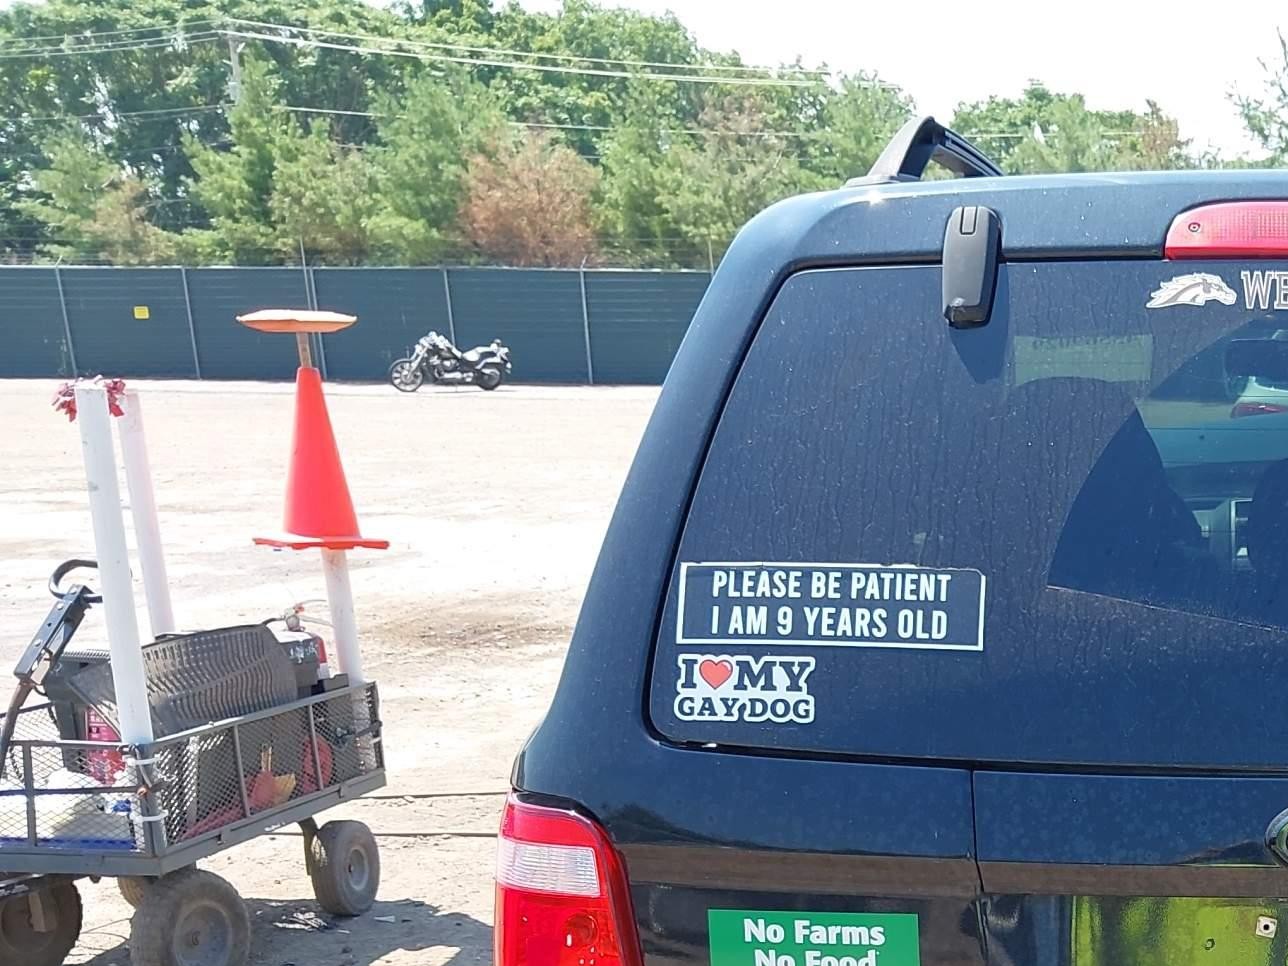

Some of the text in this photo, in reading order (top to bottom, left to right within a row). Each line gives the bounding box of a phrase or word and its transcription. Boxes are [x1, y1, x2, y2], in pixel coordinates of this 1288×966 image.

[712, 570, 951, 601] PLEASE BE PATIENT
[711, 606, 948, 639] I AM 9 YEARS OLD
[681, 659, 811, 692] I MY
[677, 697, 811, 719] GAY DOG
[743, 918, 886, 946] No Farms
